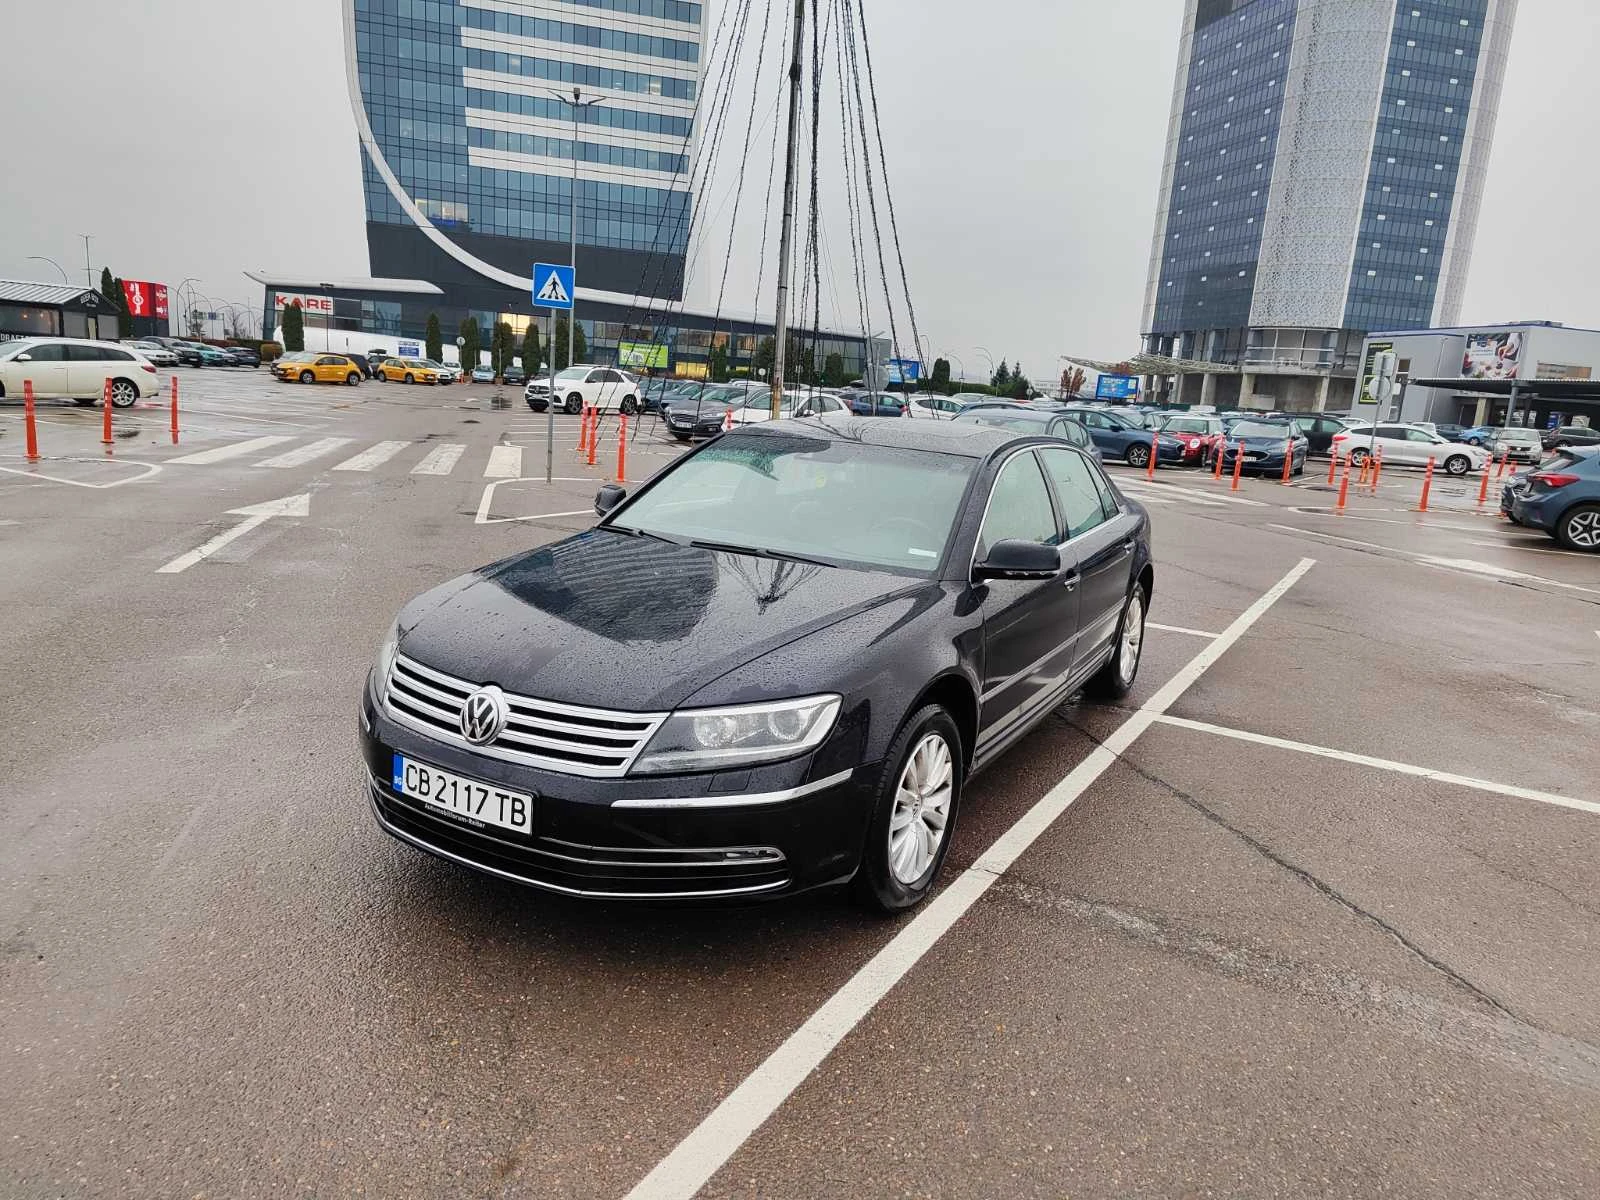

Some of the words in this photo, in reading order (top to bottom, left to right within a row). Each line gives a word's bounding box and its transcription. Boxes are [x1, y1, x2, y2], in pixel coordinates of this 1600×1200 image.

[275, 296, 332, 310] KARE
[405, 764, 431, 797] CB
[434, 775, 489, 815] 2117
[494, 792, 527, 827] TB
